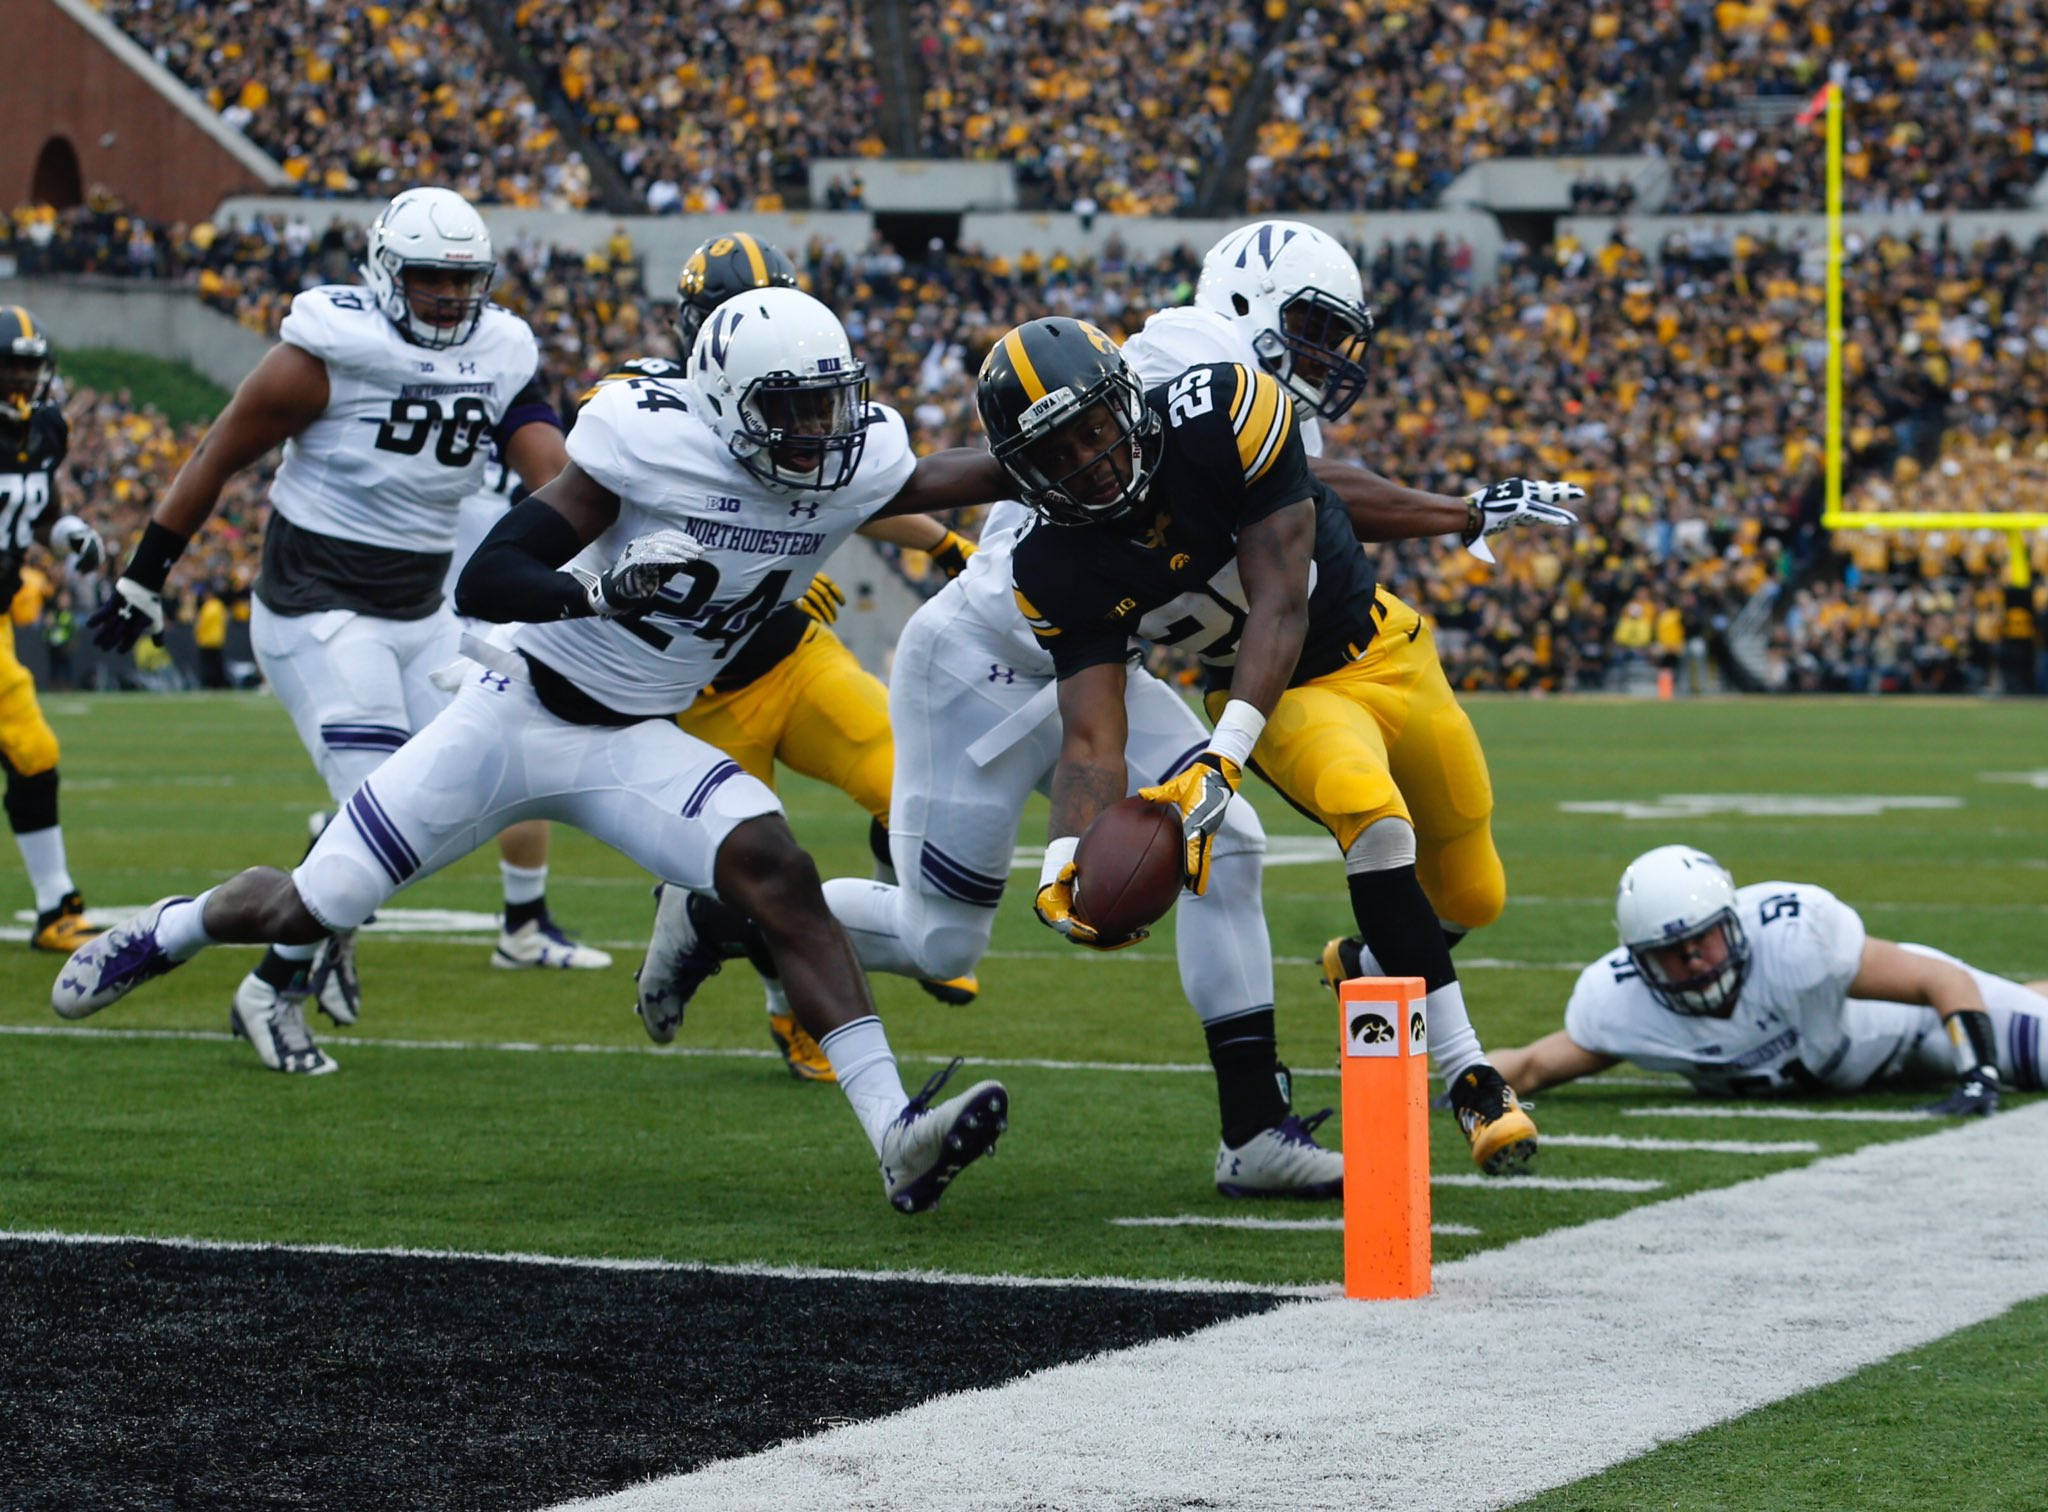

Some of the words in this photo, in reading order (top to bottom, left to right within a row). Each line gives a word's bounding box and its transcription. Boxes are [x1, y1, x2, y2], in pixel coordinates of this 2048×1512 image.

[1032, 397, 1057, 416] IOWA
[1168, 368, 1213, 428] 25
[684, 517, 826, 556] NORTHWESTERN
[613, 559, 792, 659] 24
[1137, 555, 1317, 667] 2
